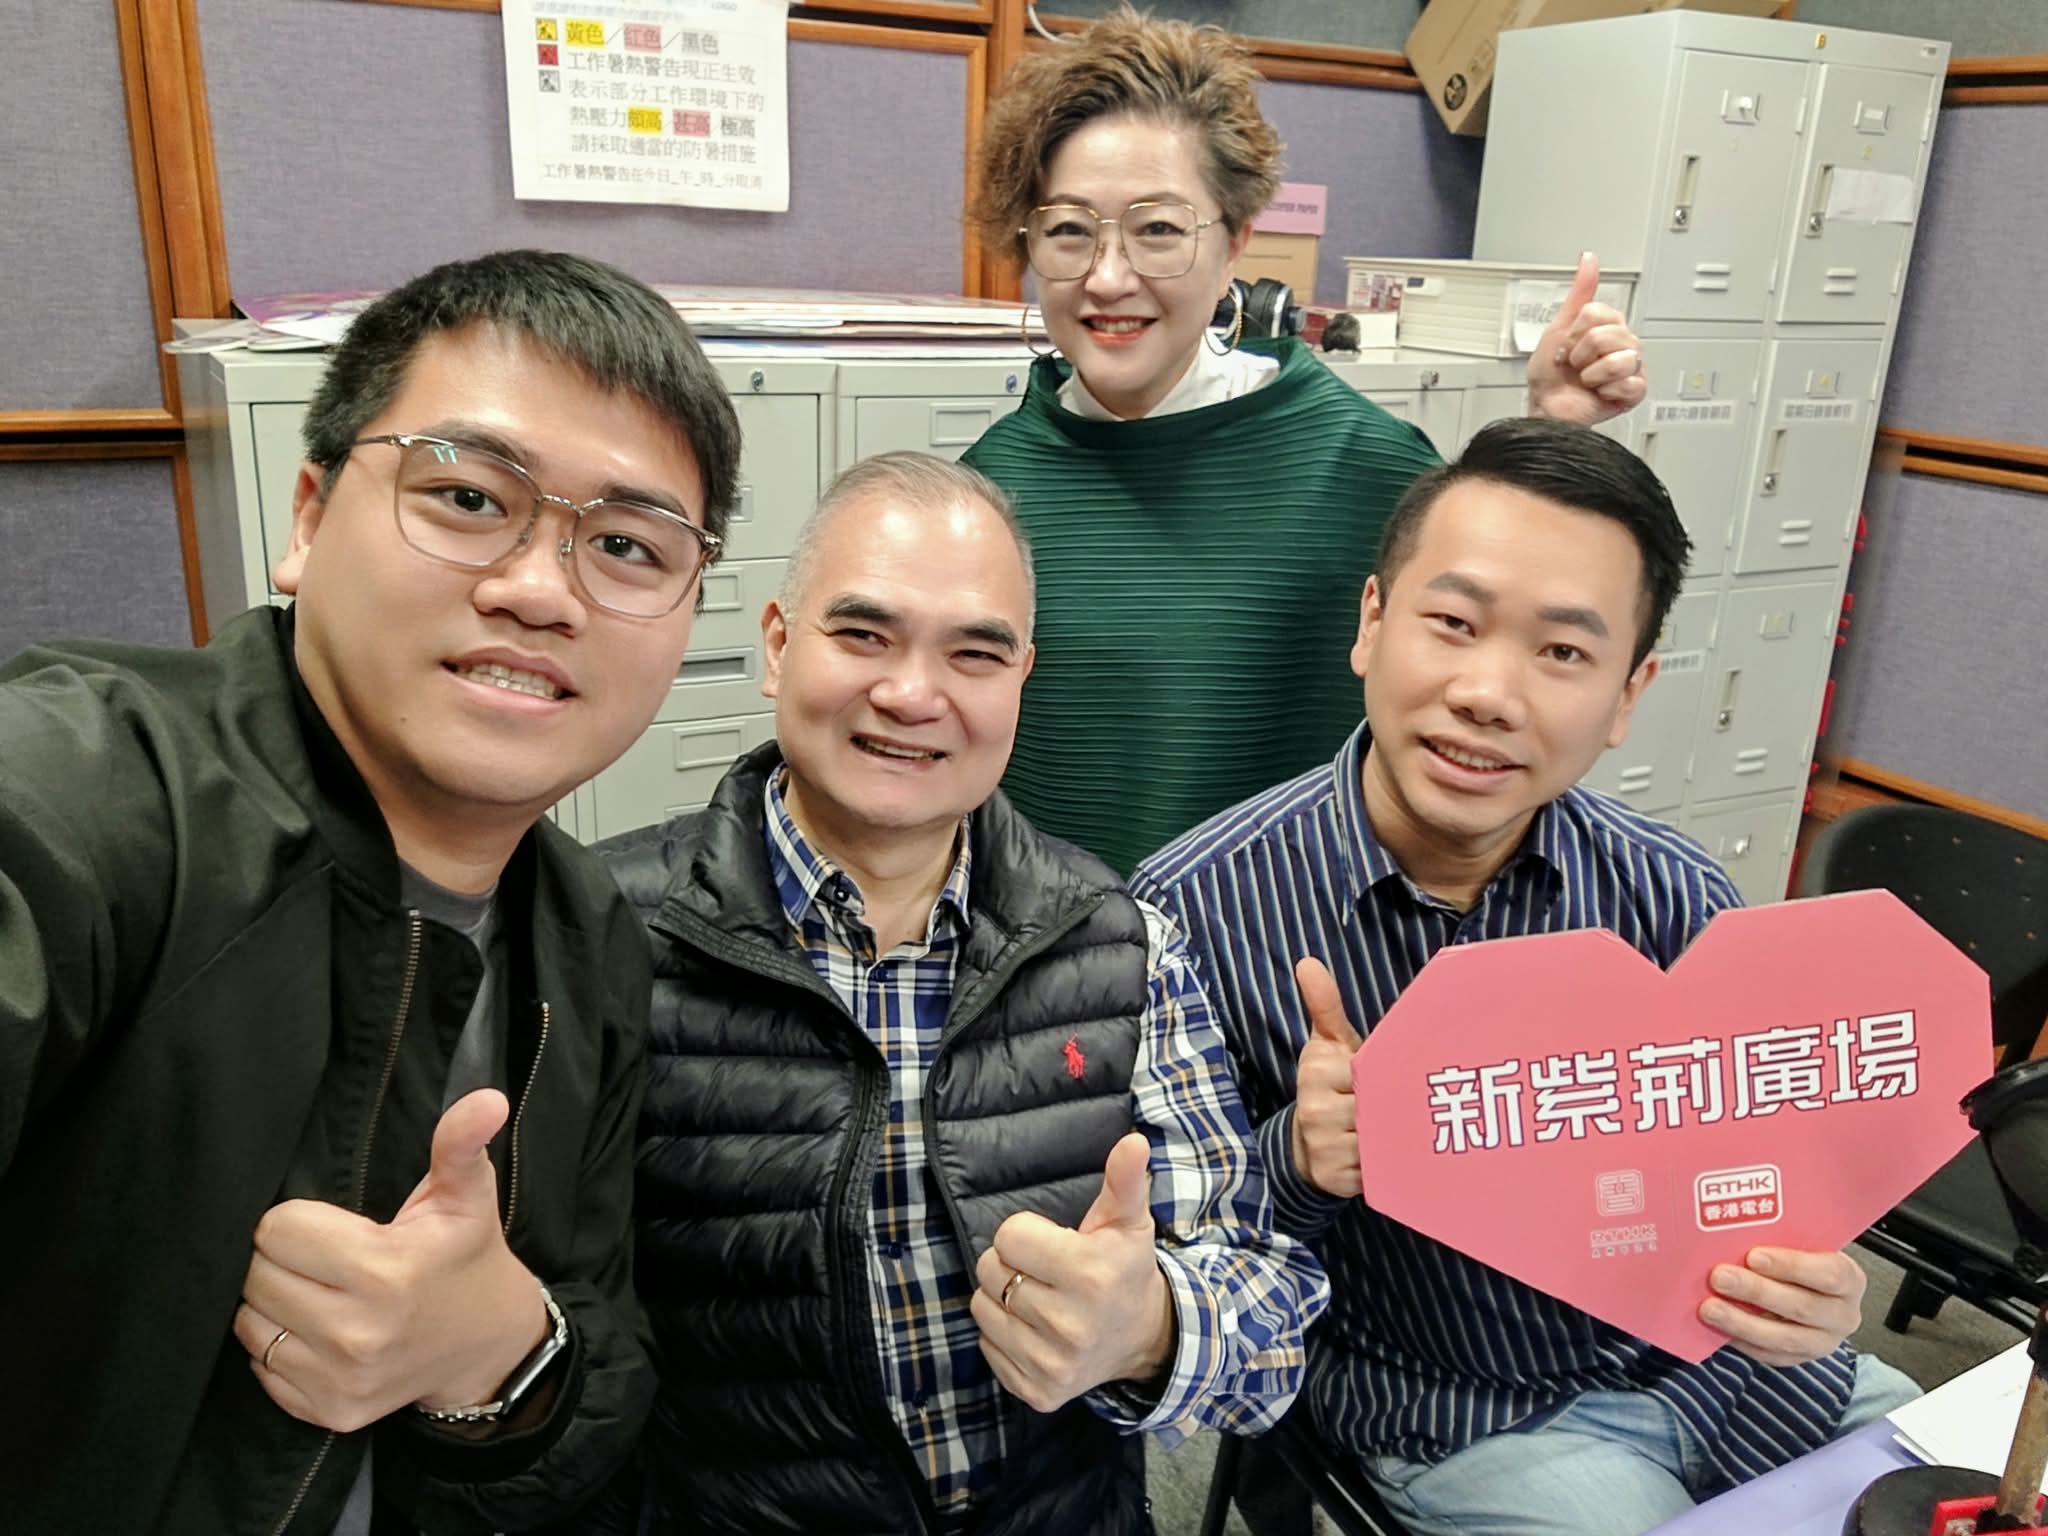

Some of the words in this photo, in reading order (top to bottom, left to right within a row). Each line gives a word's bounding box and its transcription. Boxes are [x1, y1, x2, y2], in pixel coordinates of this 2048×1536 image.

[1426, 1009, 1919, 1154] 新紫荊廣場
[1705, 1175, 1772, 1197] RTHK
[1703, 1198, 1775, 1221] 香港電台
